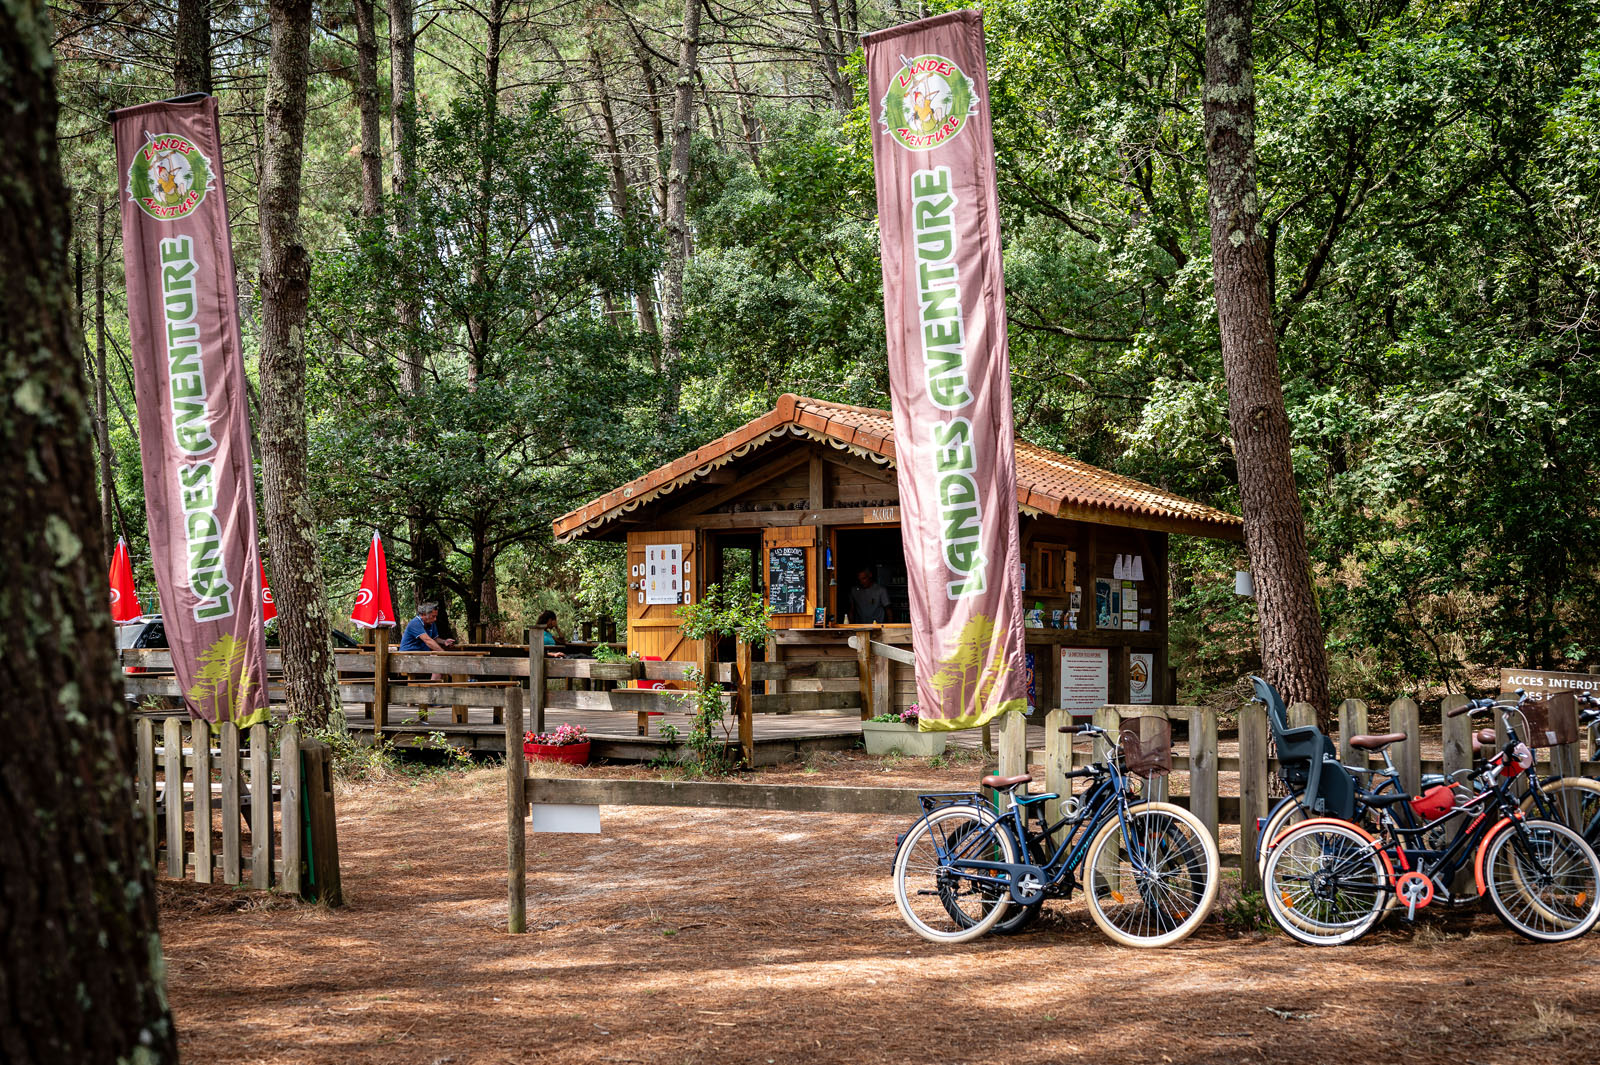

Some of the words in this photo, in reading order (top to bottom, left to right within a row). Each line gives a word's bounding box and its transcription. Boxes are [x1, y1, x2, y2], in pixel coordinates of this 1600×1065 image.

[899, 59, 956, 88] LANDES
[897, 115, 960, 147] AVENTURE
[144, 138, 196, 161] LANDES
[142, 190, 199, 217] AVENTURE
[913, 167, 971, 408] AVENTURE
[161, 237, 213, 453] AVENTURE
[933, 419, 986, 597] LANDES
[180, 463, 235, 620] LANDES
[1507, 676, 1544, 687] ACCES
[1548, 678, 1600, 690] INTERDI
